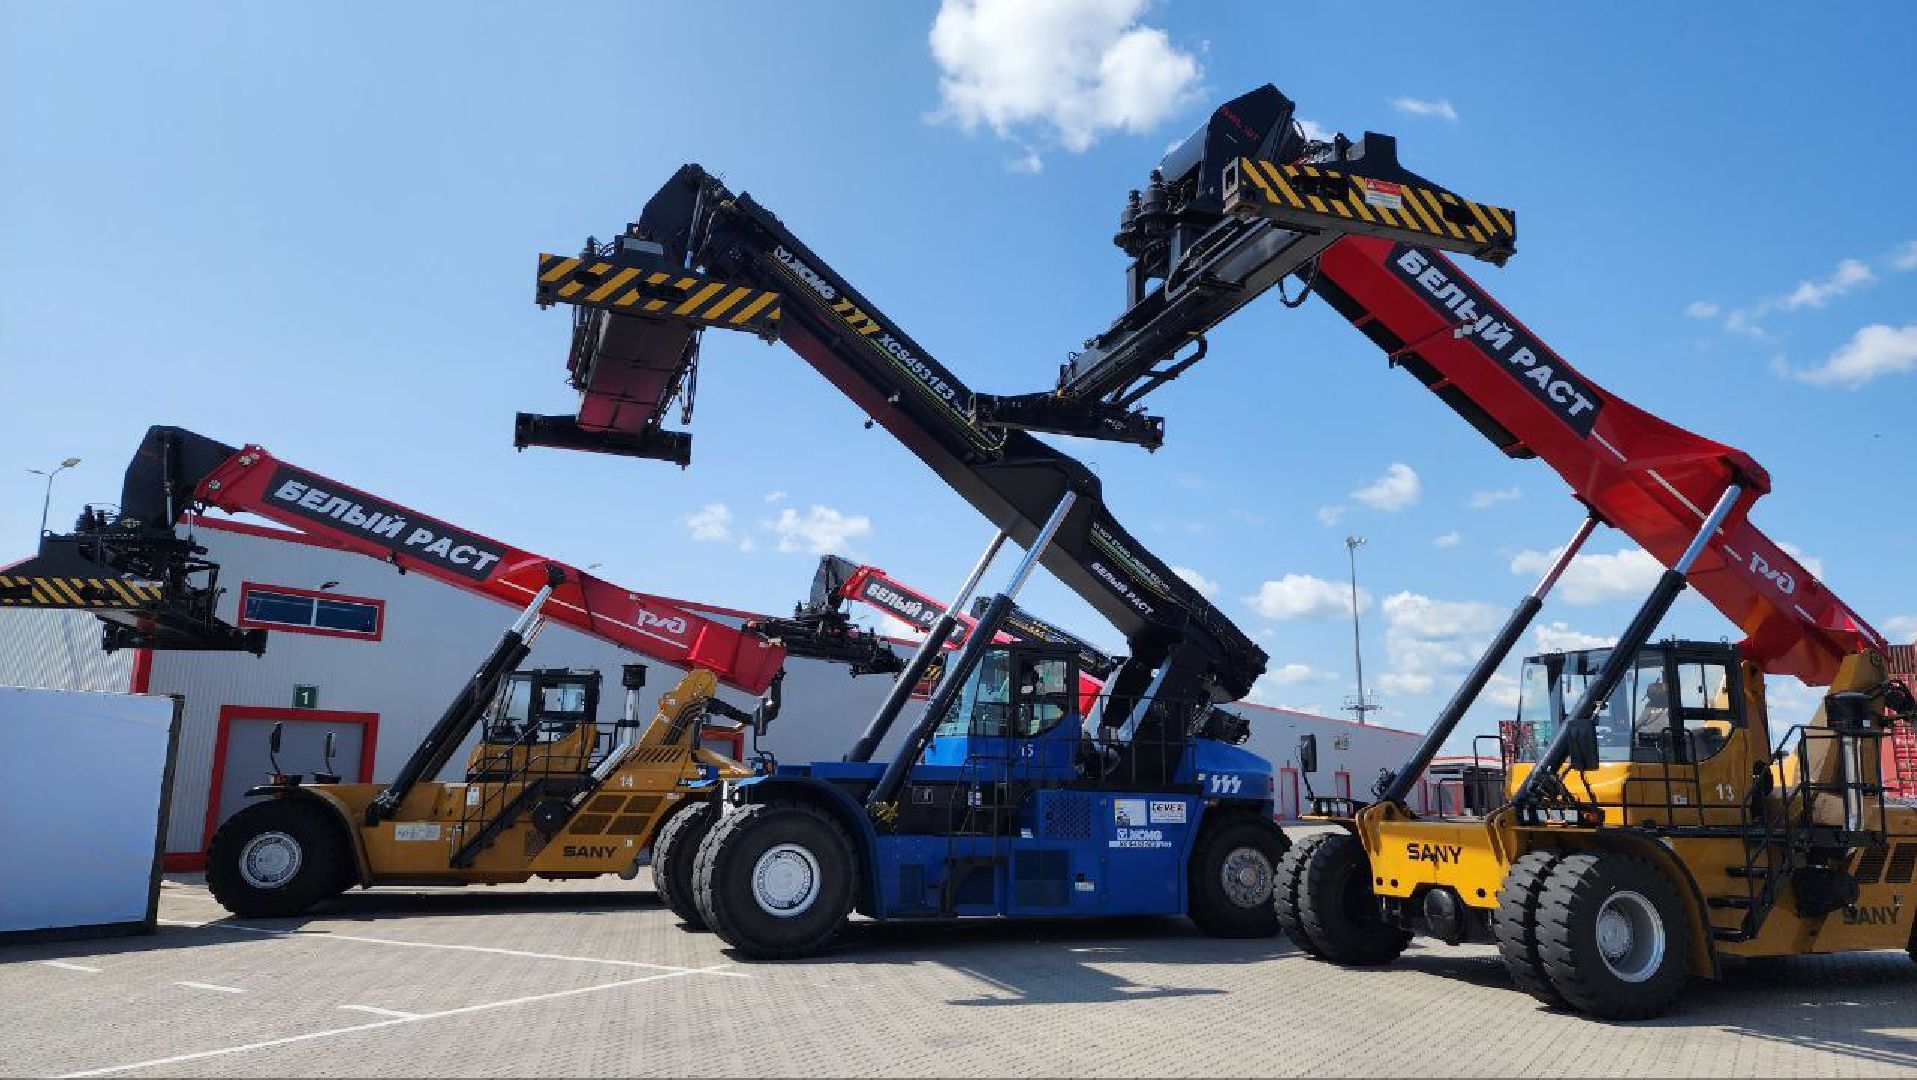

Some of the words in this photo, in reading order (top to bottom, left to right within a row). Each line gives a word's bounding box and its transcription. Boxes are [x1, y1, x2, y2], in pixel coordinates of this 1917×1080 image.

[789, 259, 836, 300] XCMG
[1397, 249, 1515, 350] БЕЛЫЙ
[1508, 346, 1594, 417] РАСТ
[273, 479, 408, 538] БЕЛЫЙ
[404, 527, 500, 571] РАСТ
[1090, 562, 1128, 594] БЕЛЫЙ
[1126, 592, 1155, 615] РАСТ
[866, 582, 922, 617] БЕЛЫЙ
[301, 691, 309, 705] 1
[620, 775, 634, 787] 14
[1715, 783, 1735, 801] 13
[1130, 829, 1163, 842] XCMG
[563, 845, 618, 859] SANY
[1407, 842, 1462, 865] SANY
[1843, 905, 1901, 925] SANY
